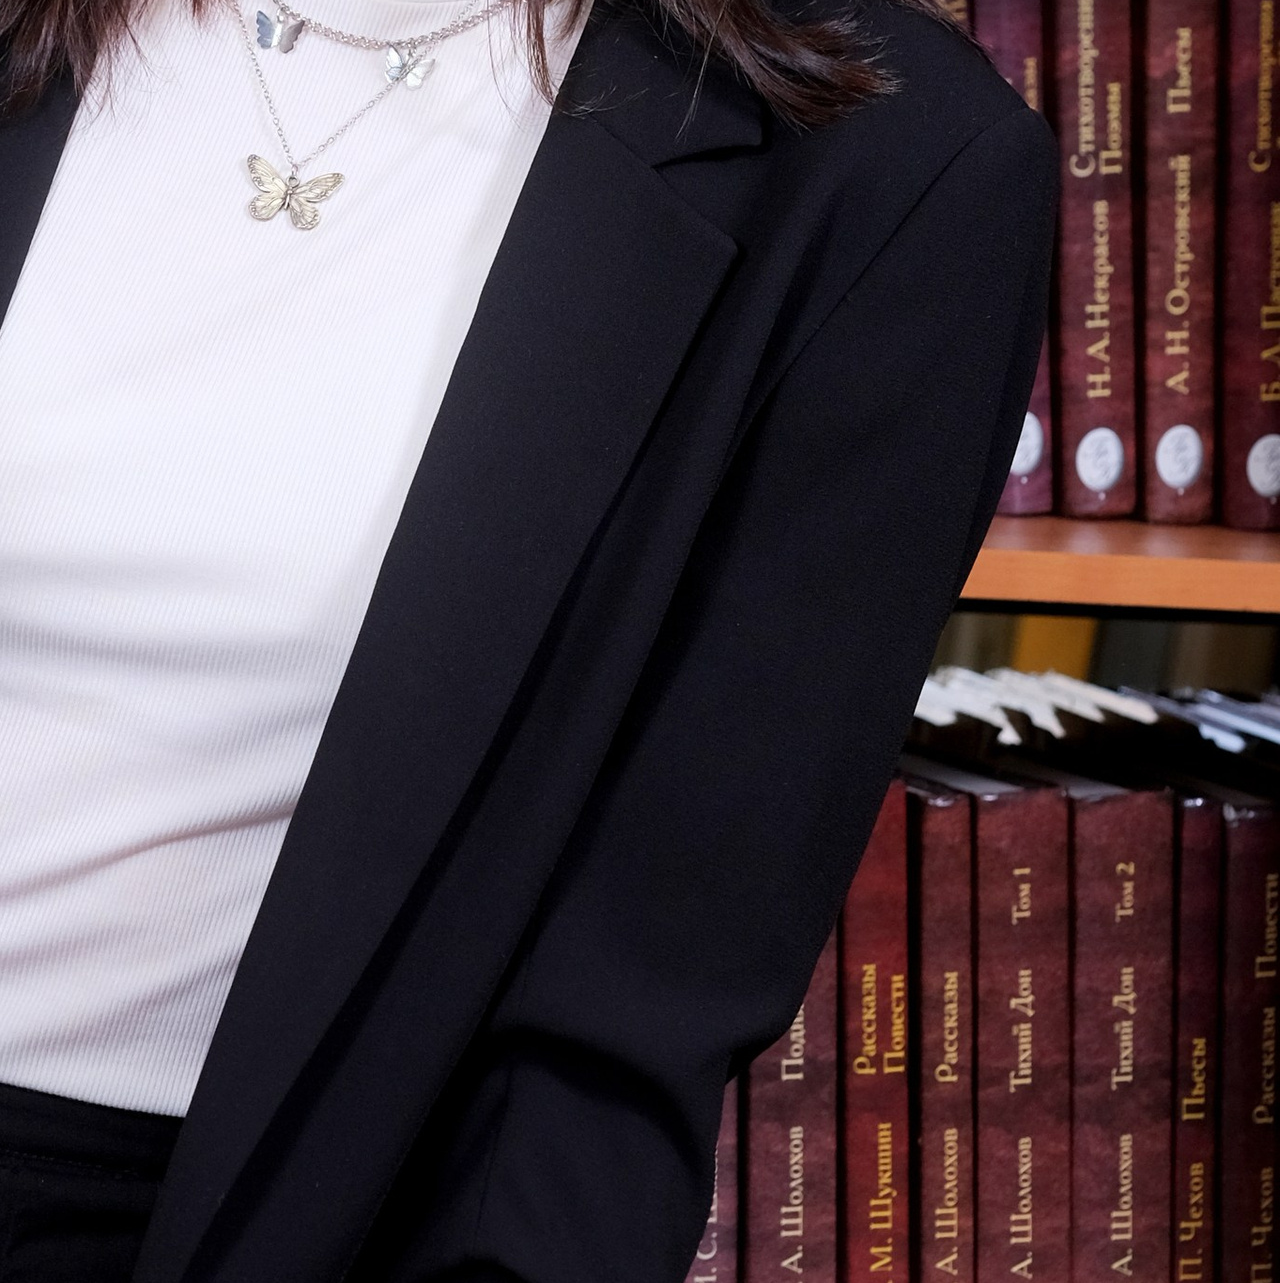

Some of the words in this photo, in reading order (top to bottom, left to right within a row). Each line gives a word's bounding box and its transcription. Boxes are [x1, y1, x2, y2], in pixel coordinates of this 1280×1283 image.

[1166, 27, 1192, 114] Пьесы
[1098, 81, 1122, 175] Поэмы
[1084, 200, 1115, 328] Некрасов
[1164, 154, 1195, 316] Островский
[1165, 320, 1190, 356] Н.
[1165, 361, 1190, 395] А.
[1011, 883, 1032, 925] Том
[1114, 880, 1134, 922] Том
[1115, 862, 1135, 877] 2
[1254, 873, 1280, 980] Повести
[853, 964, 877, 1076] Рассказы
[883, 973, 906, 1074] Повести
[933, 971, 959, 1084] Рассказы
[1011, 968, 1036, 1017] Дон
[1111, 966, 1137, 1015] Дон
[1009, 1022, 1033, 1093] Тихий
[1110, 1020, 1134, 1090] Тихий
[1180, 1037, 1206, 1122] Пьесы
[1251, 1006, 1277, 1125] Рассказы
[780, 1125, 805, 1238] Шолохов
[870, 1122, 899, 1230] Шукшин
[935, 1128, 959, 1239] Шолохов
[1009, 1136, 1032, 1245] Шолохов
[1110, 1134, 1134, 1242] Шолохов
[1179, 1162, 1205, 1242] Чехов
[1250, 1167, 1274, 1247] Чехов
[694, 1232, 718, 1260] С.
[780, 1245, 804, 1275] А.
[870, 1238, 894, 1272] М.
[935, 1246, 958, 1276] А.
[1010, 1251, 1032, 1280] А.
[1111, 1248, 1133, 1277] А.
[1179, 1248, 1203, 1281] П.
